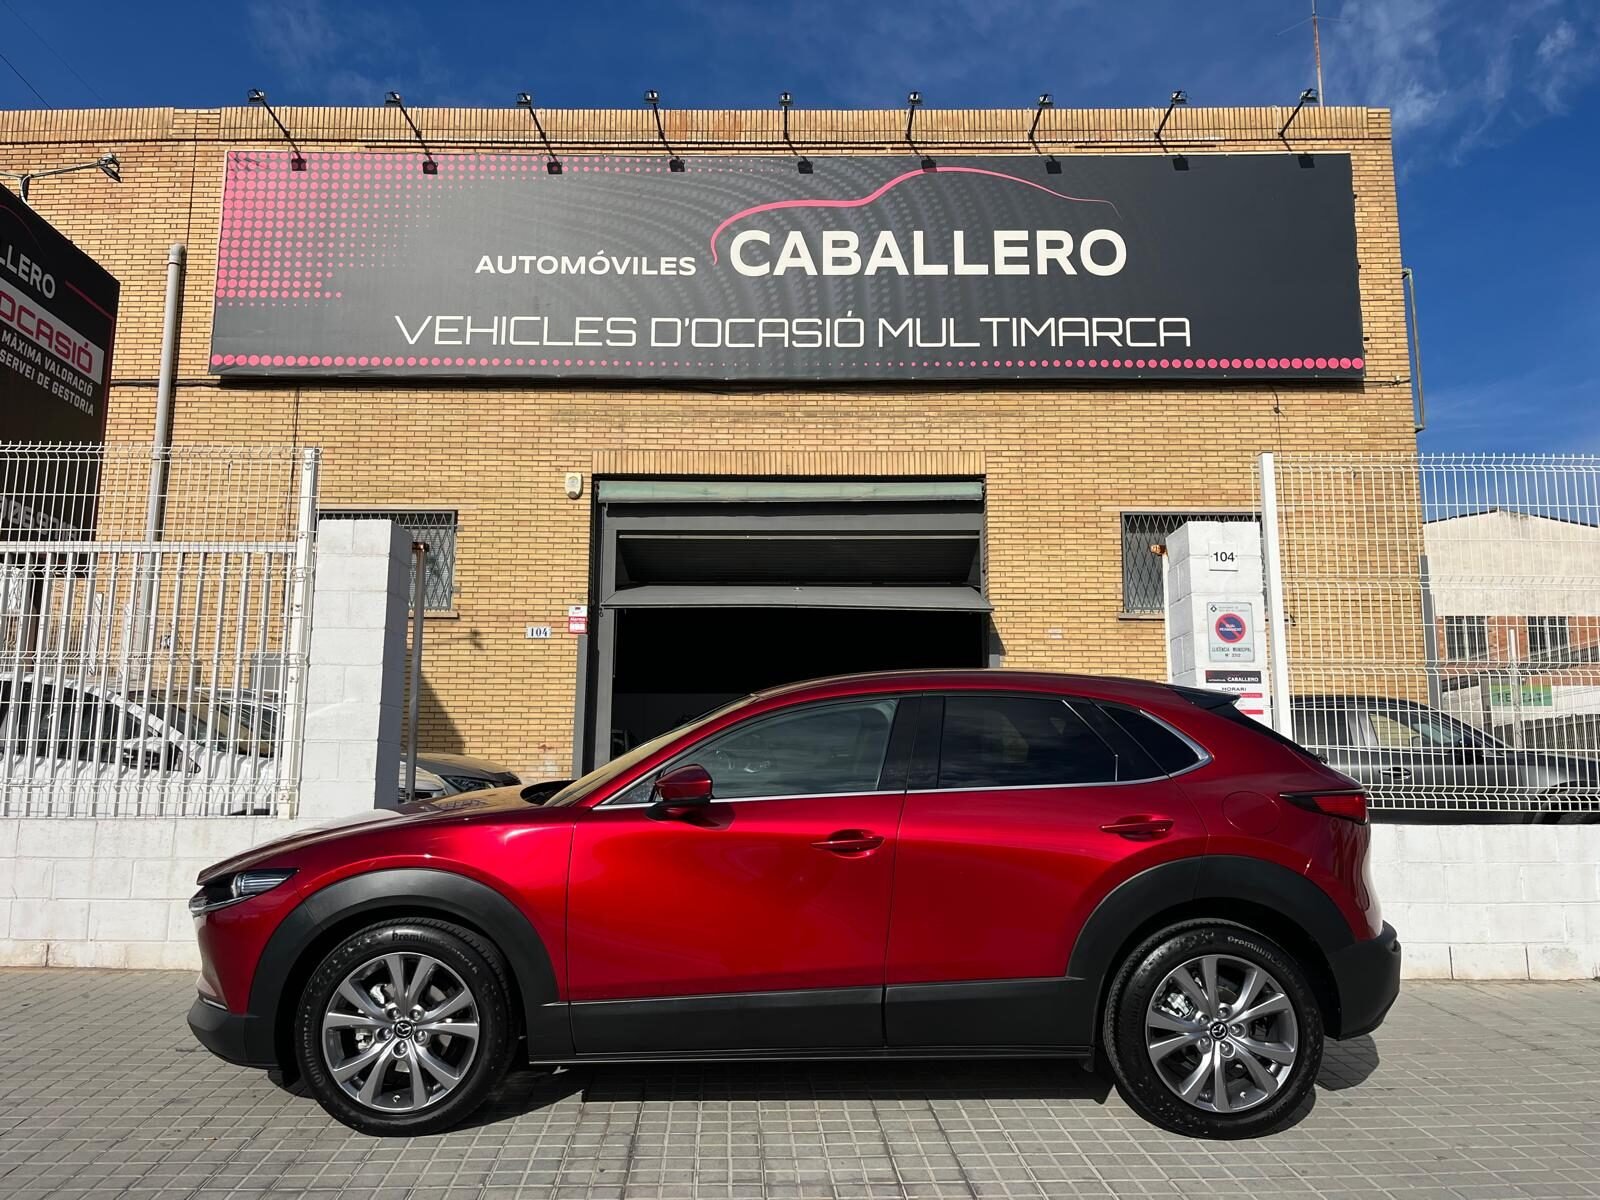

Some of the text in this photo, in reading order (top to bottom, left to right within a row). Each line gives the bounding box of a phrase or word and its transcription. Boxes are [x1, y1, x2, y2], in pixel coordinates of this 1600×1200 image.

[474, 228, 1128, 278] AUTOMÓVILES CABALLERO
[394, 310, 1192, 349] VEHICLES D'OCASIÓ MULTIMARCA
[0, 349, 94, 417] SERVEI DE GESTORIA
[2, 330, 94, 397] MÀXIMA VALORACIÓ
[1213, 551, 1235, 562] 104
[530, 627, 548, 637] 104
